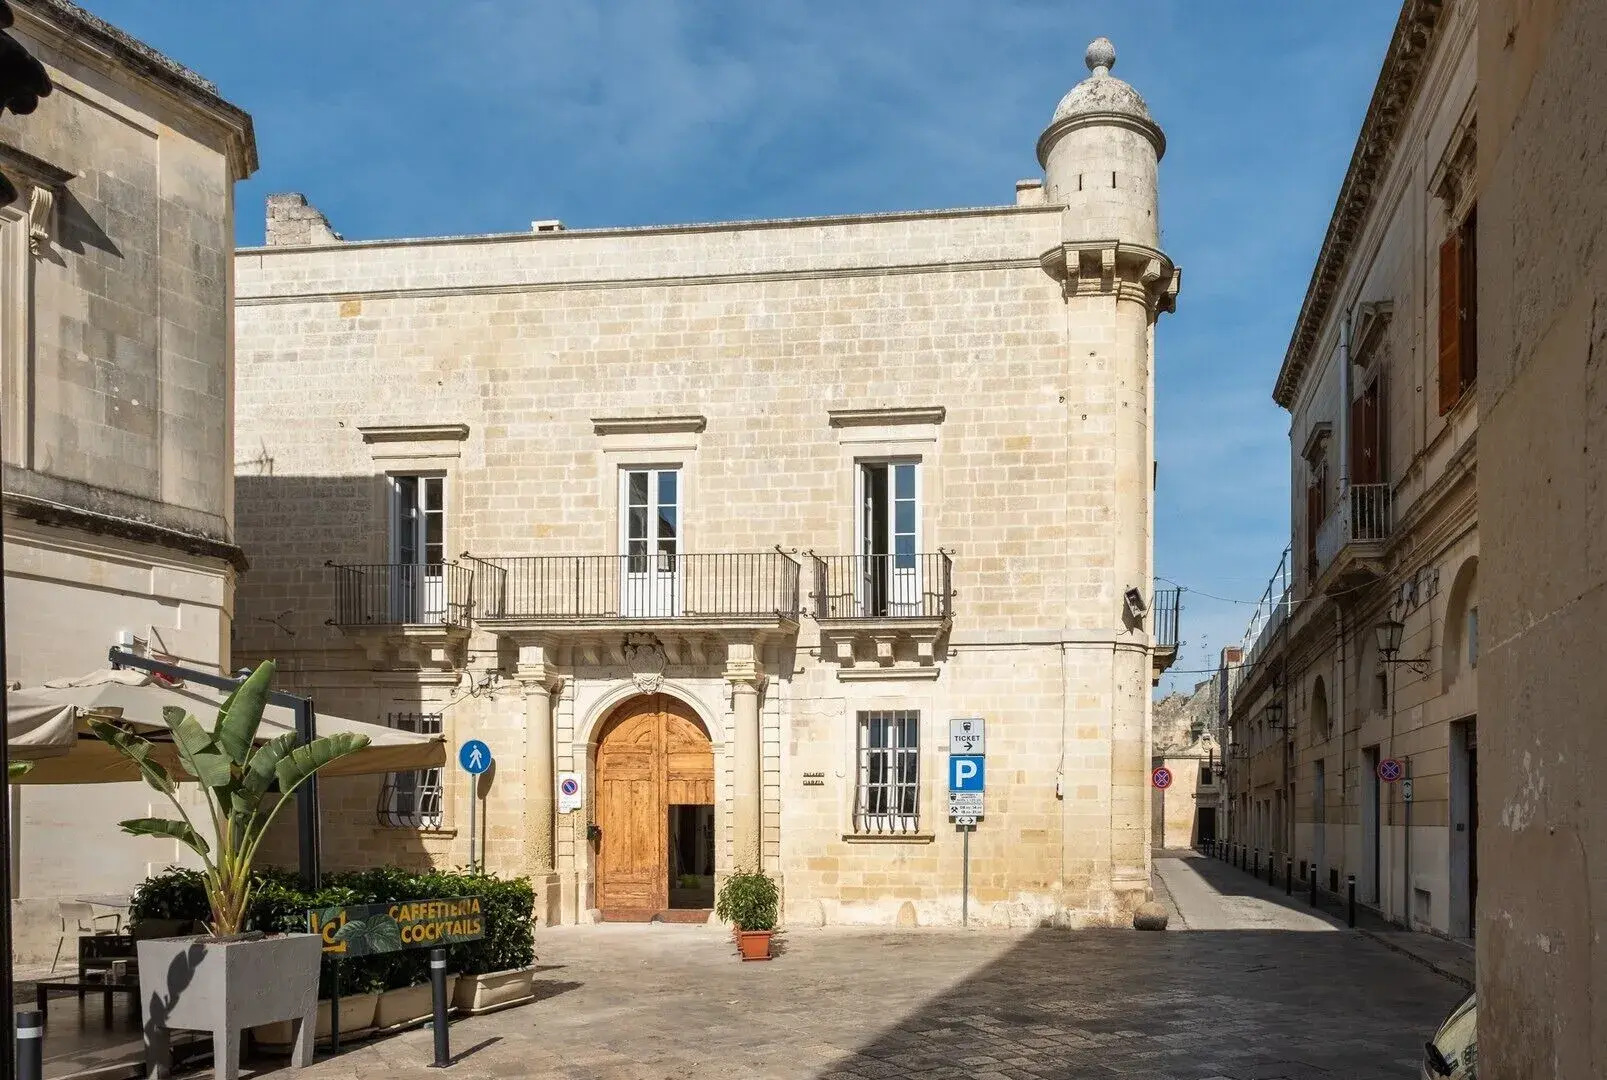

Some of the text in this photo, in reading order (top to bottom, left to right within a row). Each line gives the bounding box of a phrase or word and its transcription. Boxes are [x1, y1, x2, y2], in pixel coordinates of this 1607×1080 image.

[955, 759, 978, 788] P
[388, 898, 481, 923] CAFFETTERIA
[401, 917, 481, 944] COCKTAILS
